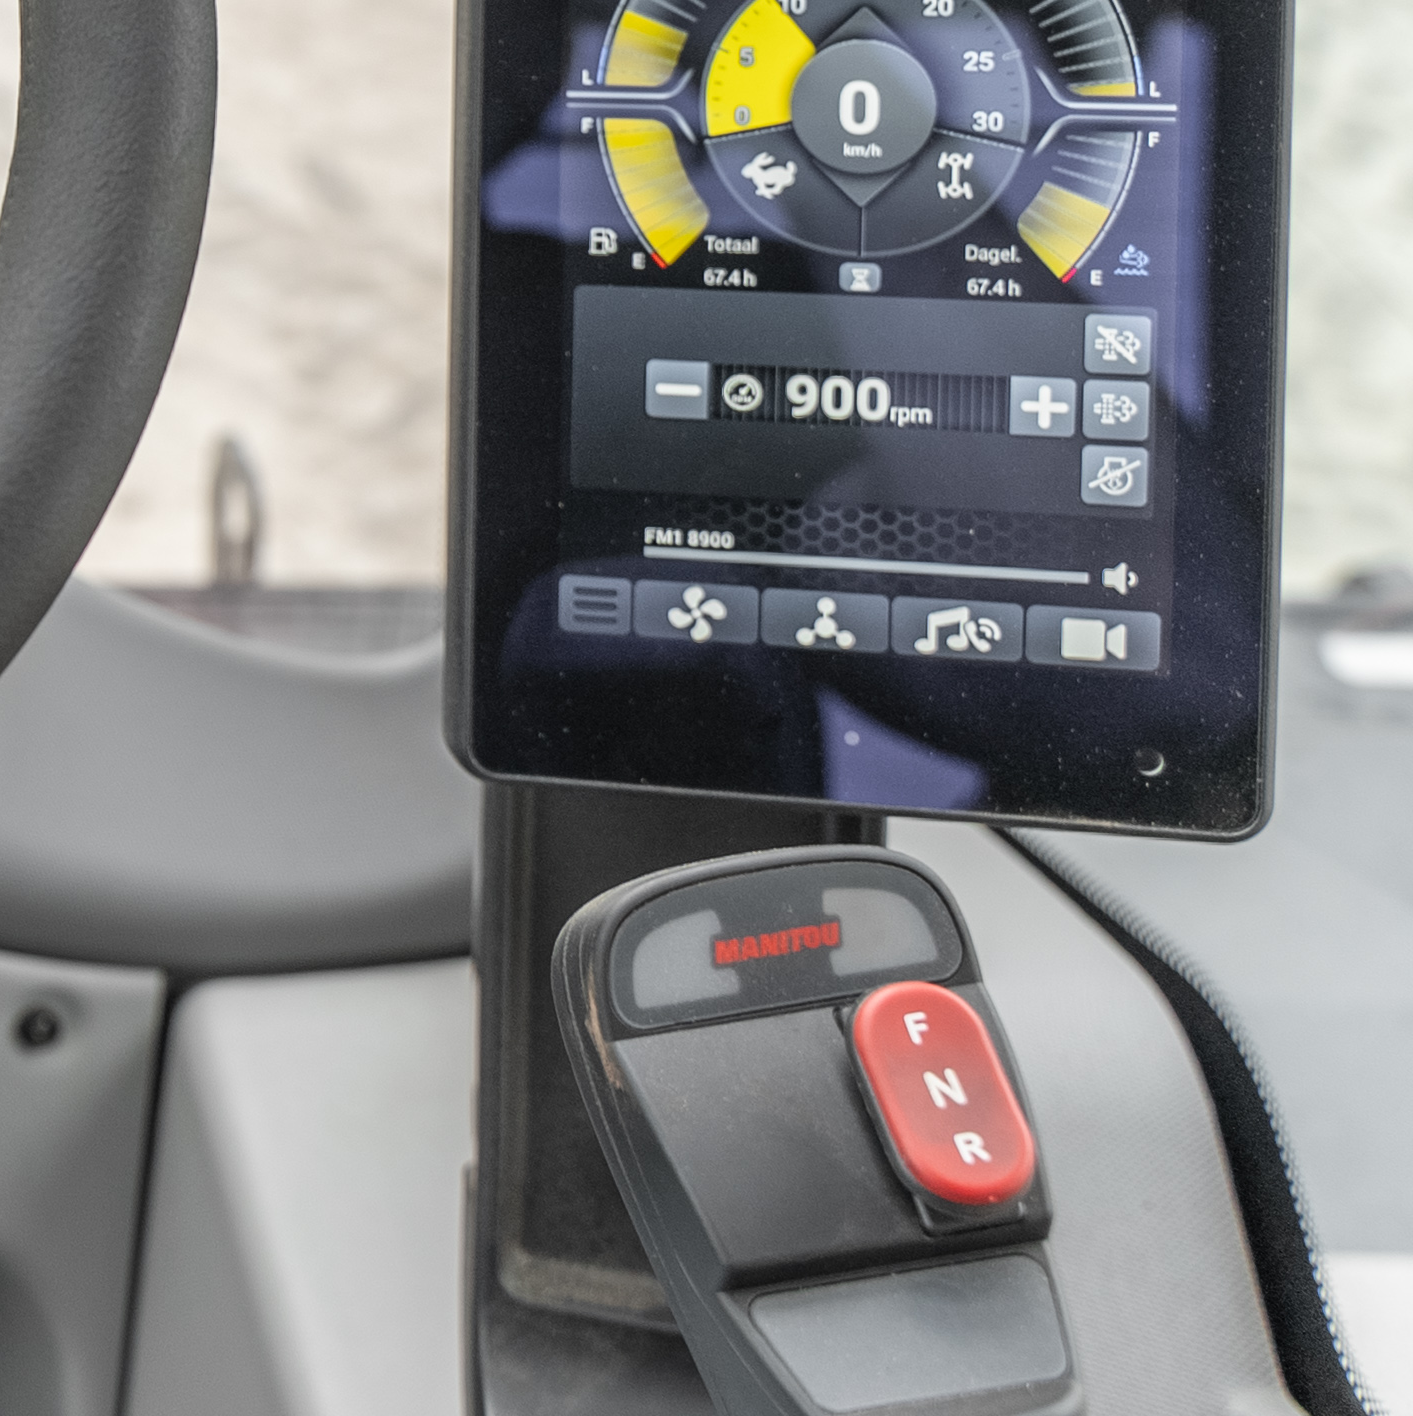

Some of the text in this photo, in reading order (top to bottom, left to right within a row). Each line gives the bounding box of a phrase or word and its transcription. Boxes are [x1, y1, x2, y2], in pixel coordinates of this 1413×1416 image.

[739, 47, 754, 67] 5
[963, 50, 995, 73] 25
[582, 70, 593, 85] L
[1149, 82, 1161, 98] L
[734, 105, 750, 126] 0
[839, 80, 881, 135] 0
[581, 117, 594, 133] F
[972, 111, 1004, 133] 30
[1148, 131, 1160, 147] F
[842, 142, 883, 159] km/h
[703, 234, 760, 255] Totaal
[965, 244, 1022, 266] Dagel.
[633, 253, 646, 270] E
[703, 267, 741, 287] 67.4
[967, 277, 1006, 296] 67.4
[1090, 270, 1103, 286] E
[786, 374, 933, 427] 900 rpm
[644, 526, 735, 549] FM1 8900
[715, 922, 840, 965] MANITOU
[903, 1011, 929, 1045] F
[923, 1067, 969, 1108] N
[953, 1132, 992, 1164] R
